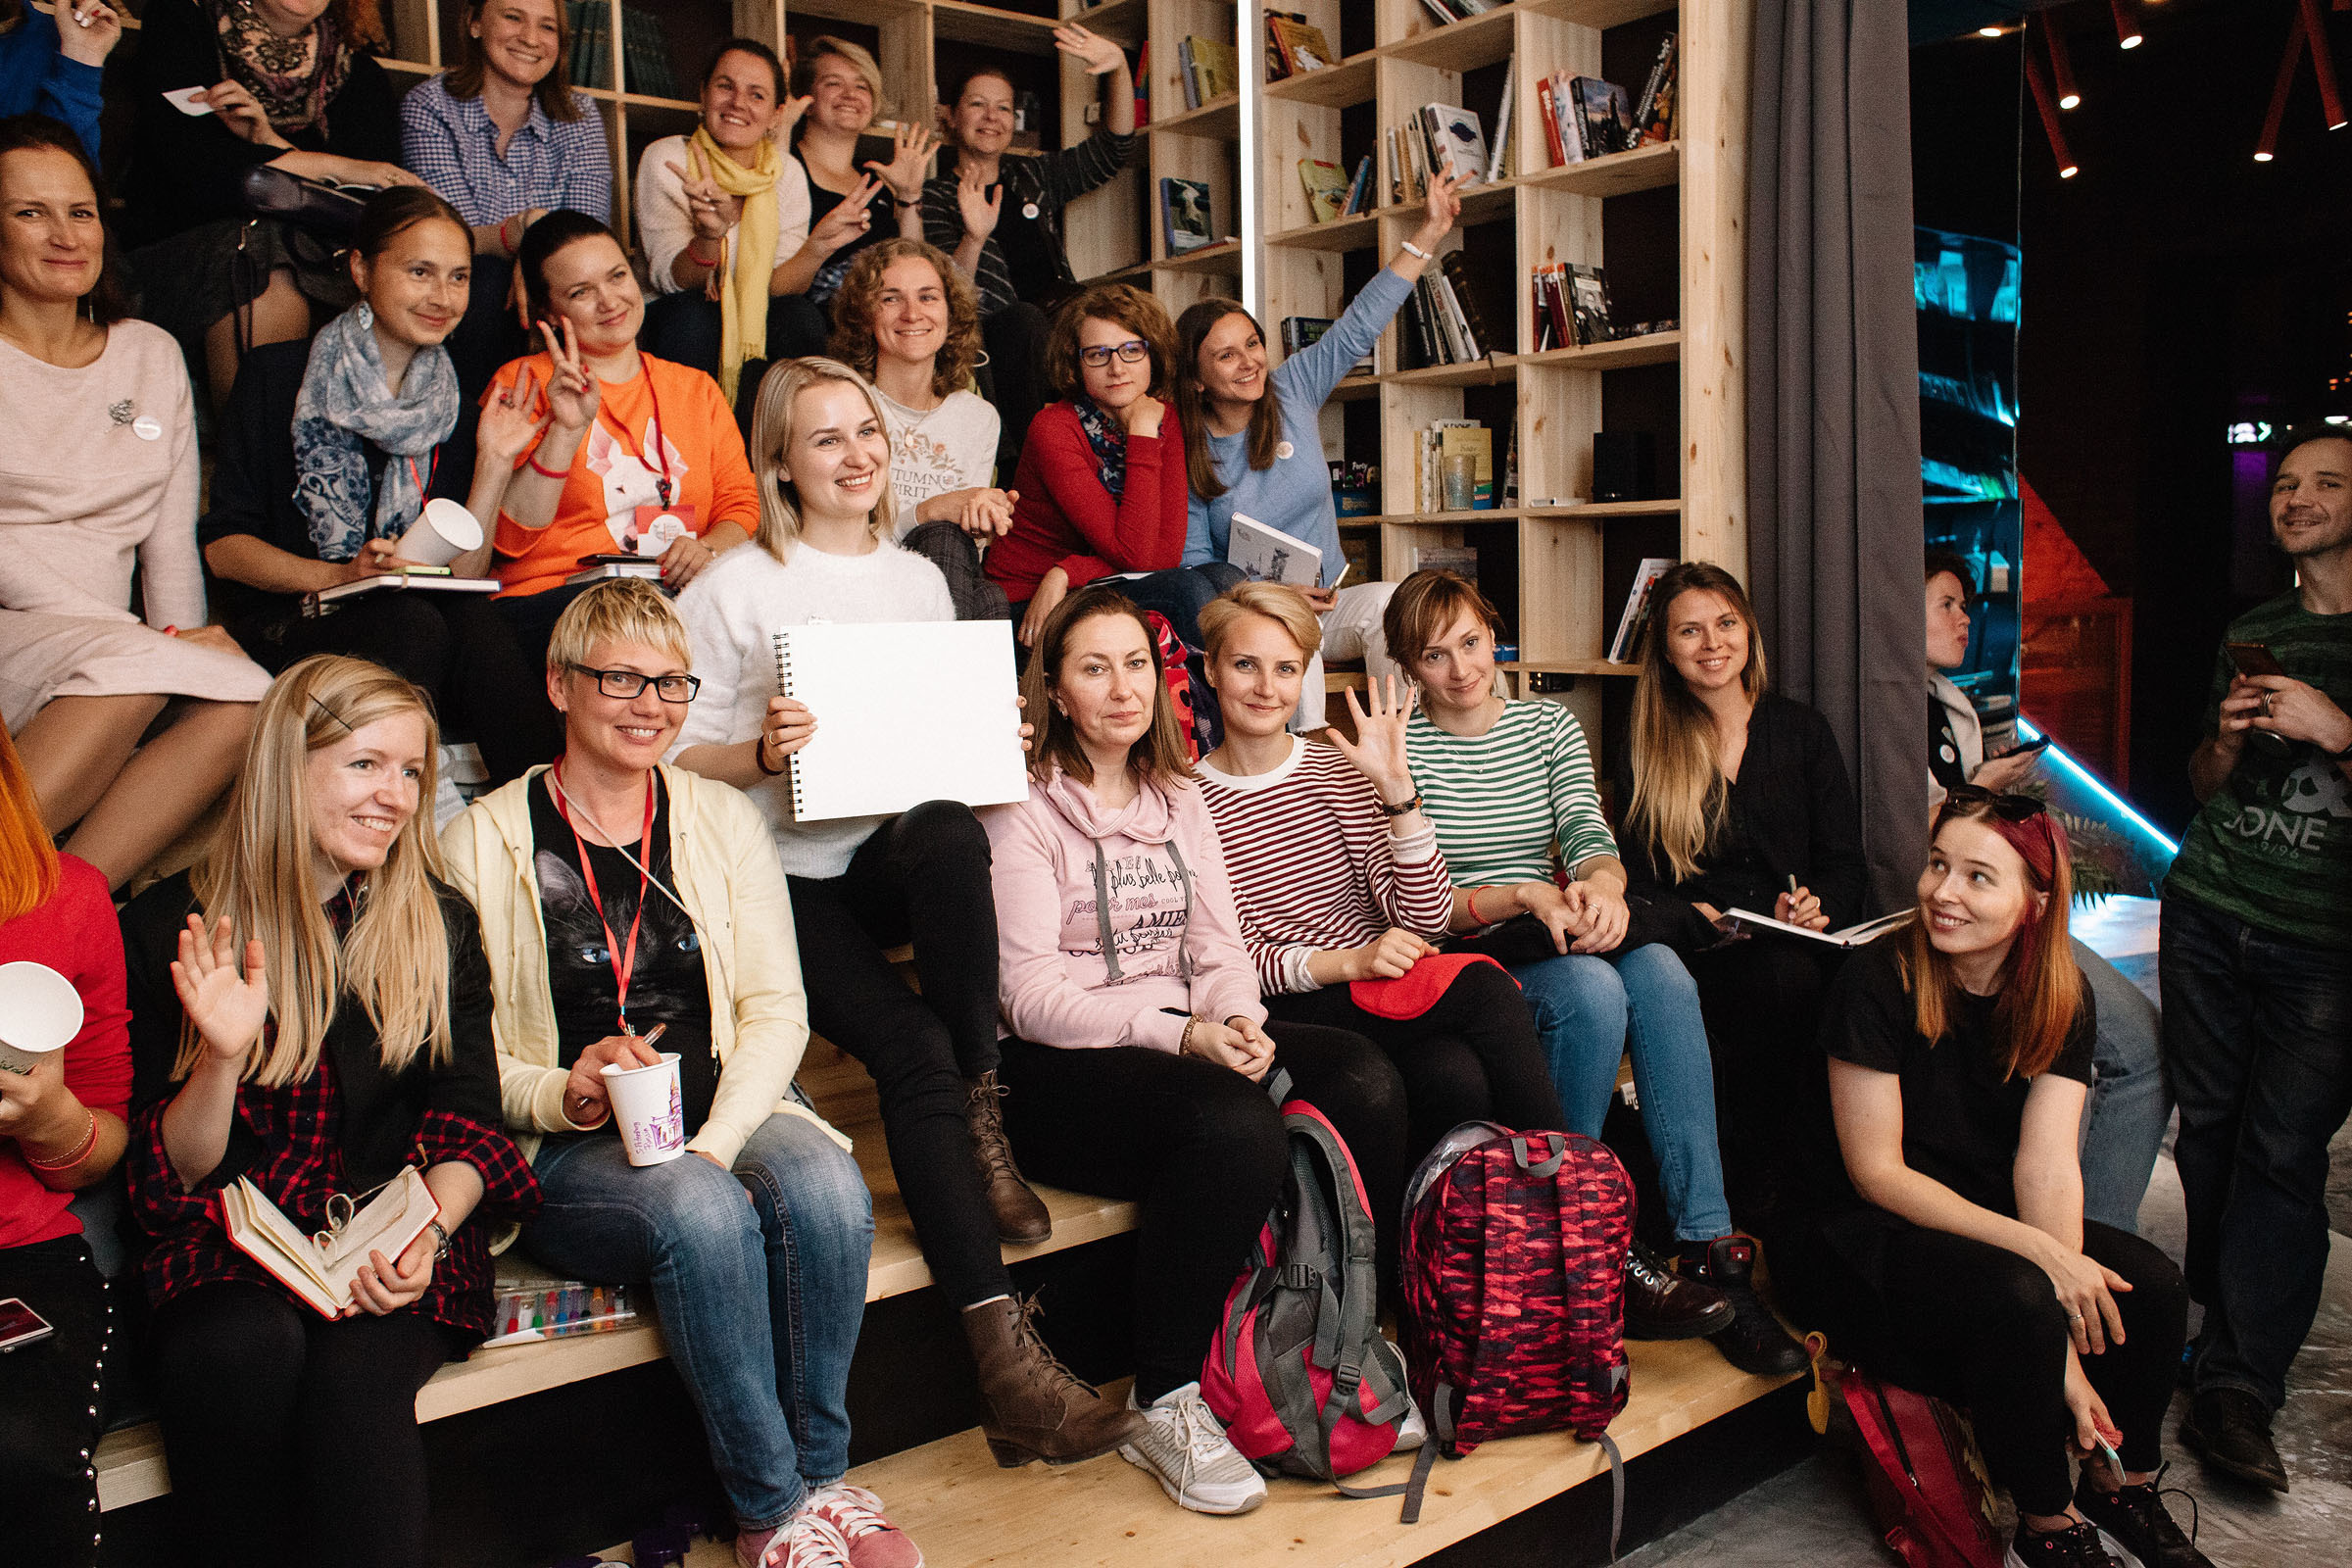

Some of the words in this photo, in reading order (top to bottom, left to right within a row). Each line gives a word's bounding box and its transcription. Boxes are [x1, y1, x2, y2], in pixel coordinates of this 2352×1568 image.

[891, 467, 942, 485] TUMN
[893, 482, 930, 499] PIRIT
[1125, 893, 1159, 911] mes
